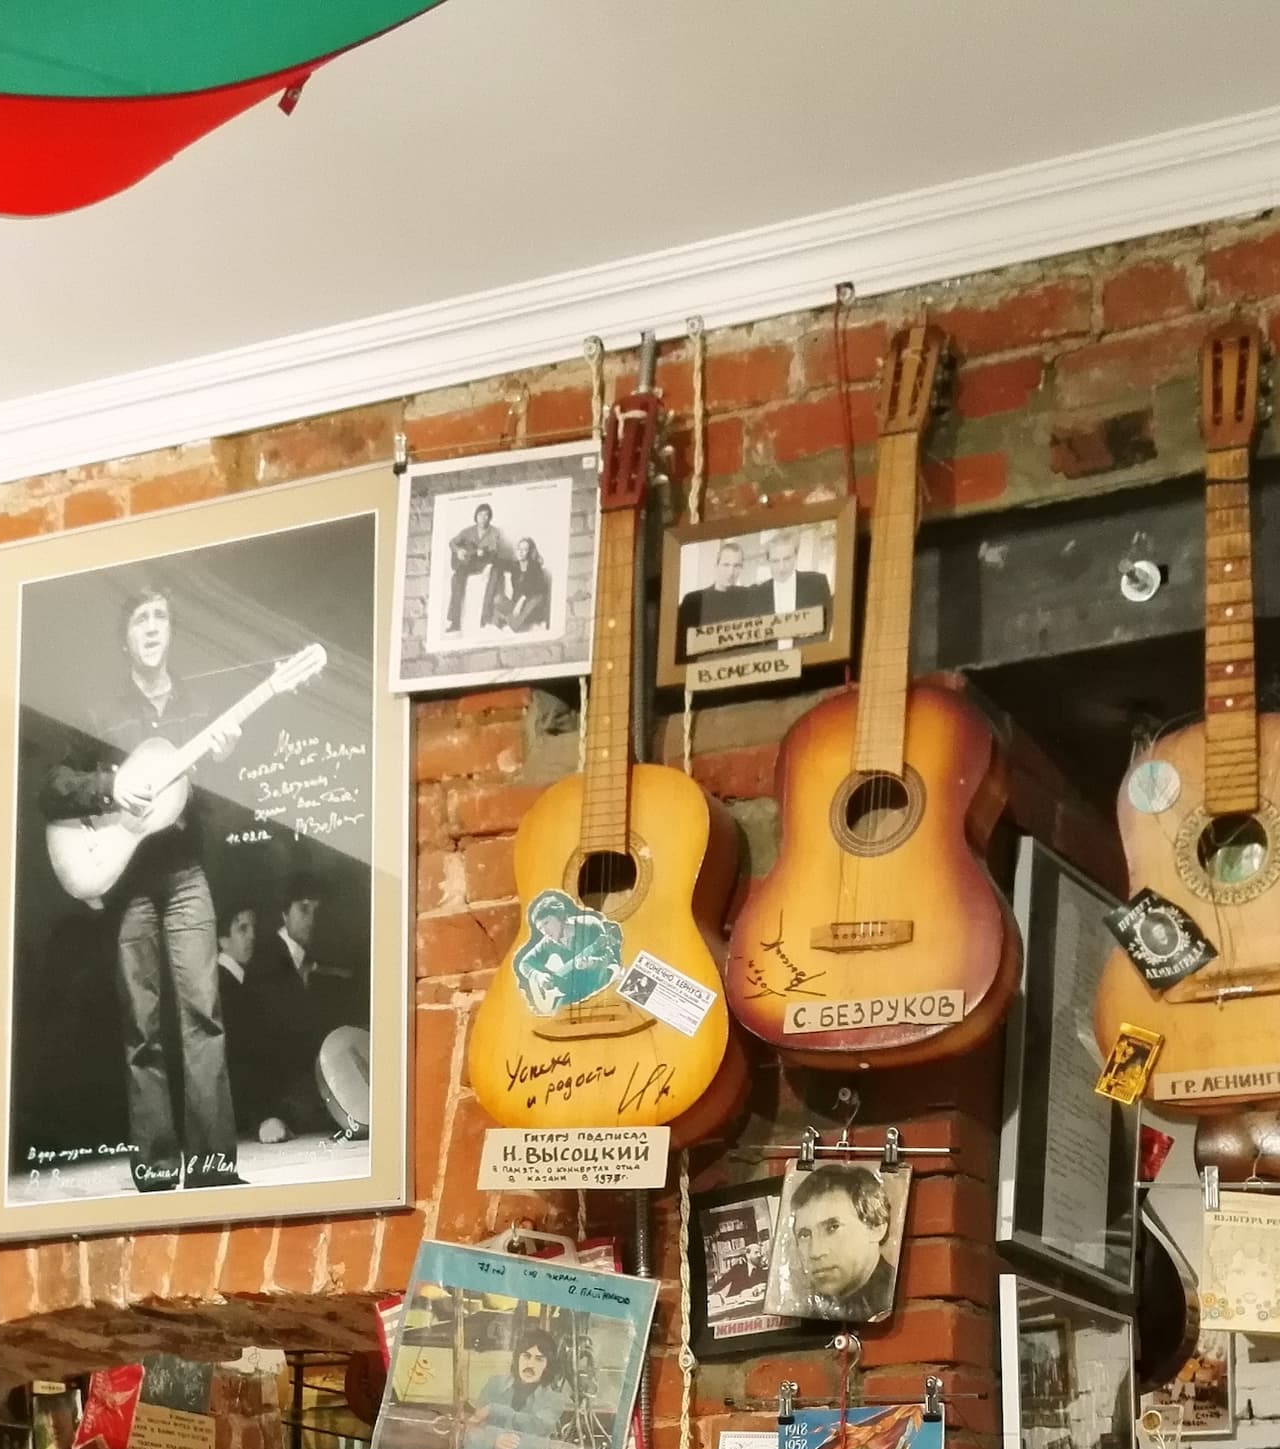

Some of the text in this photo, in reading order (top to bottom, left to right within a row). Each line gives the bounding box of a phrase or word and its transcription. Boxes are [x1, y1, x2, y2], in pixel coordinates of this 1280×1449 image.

[696, 611, 811, 637] ХОРОШИЙ ДРУГ
[718, 627, 775, 645] МУЗЕЯ
[793, 996, 955, 1029] С. БЕЗРУКОВ
[506, 1053, 571, 1092] Успеха
[1170, 1078, 1200, 1096] ГР.
[527, 1096, 536, 1109] и
[524, 1131, 648, 1143] ГИТАРУ ПОДПИСАЛ
[785, 1422, 809, 1436] 1918
